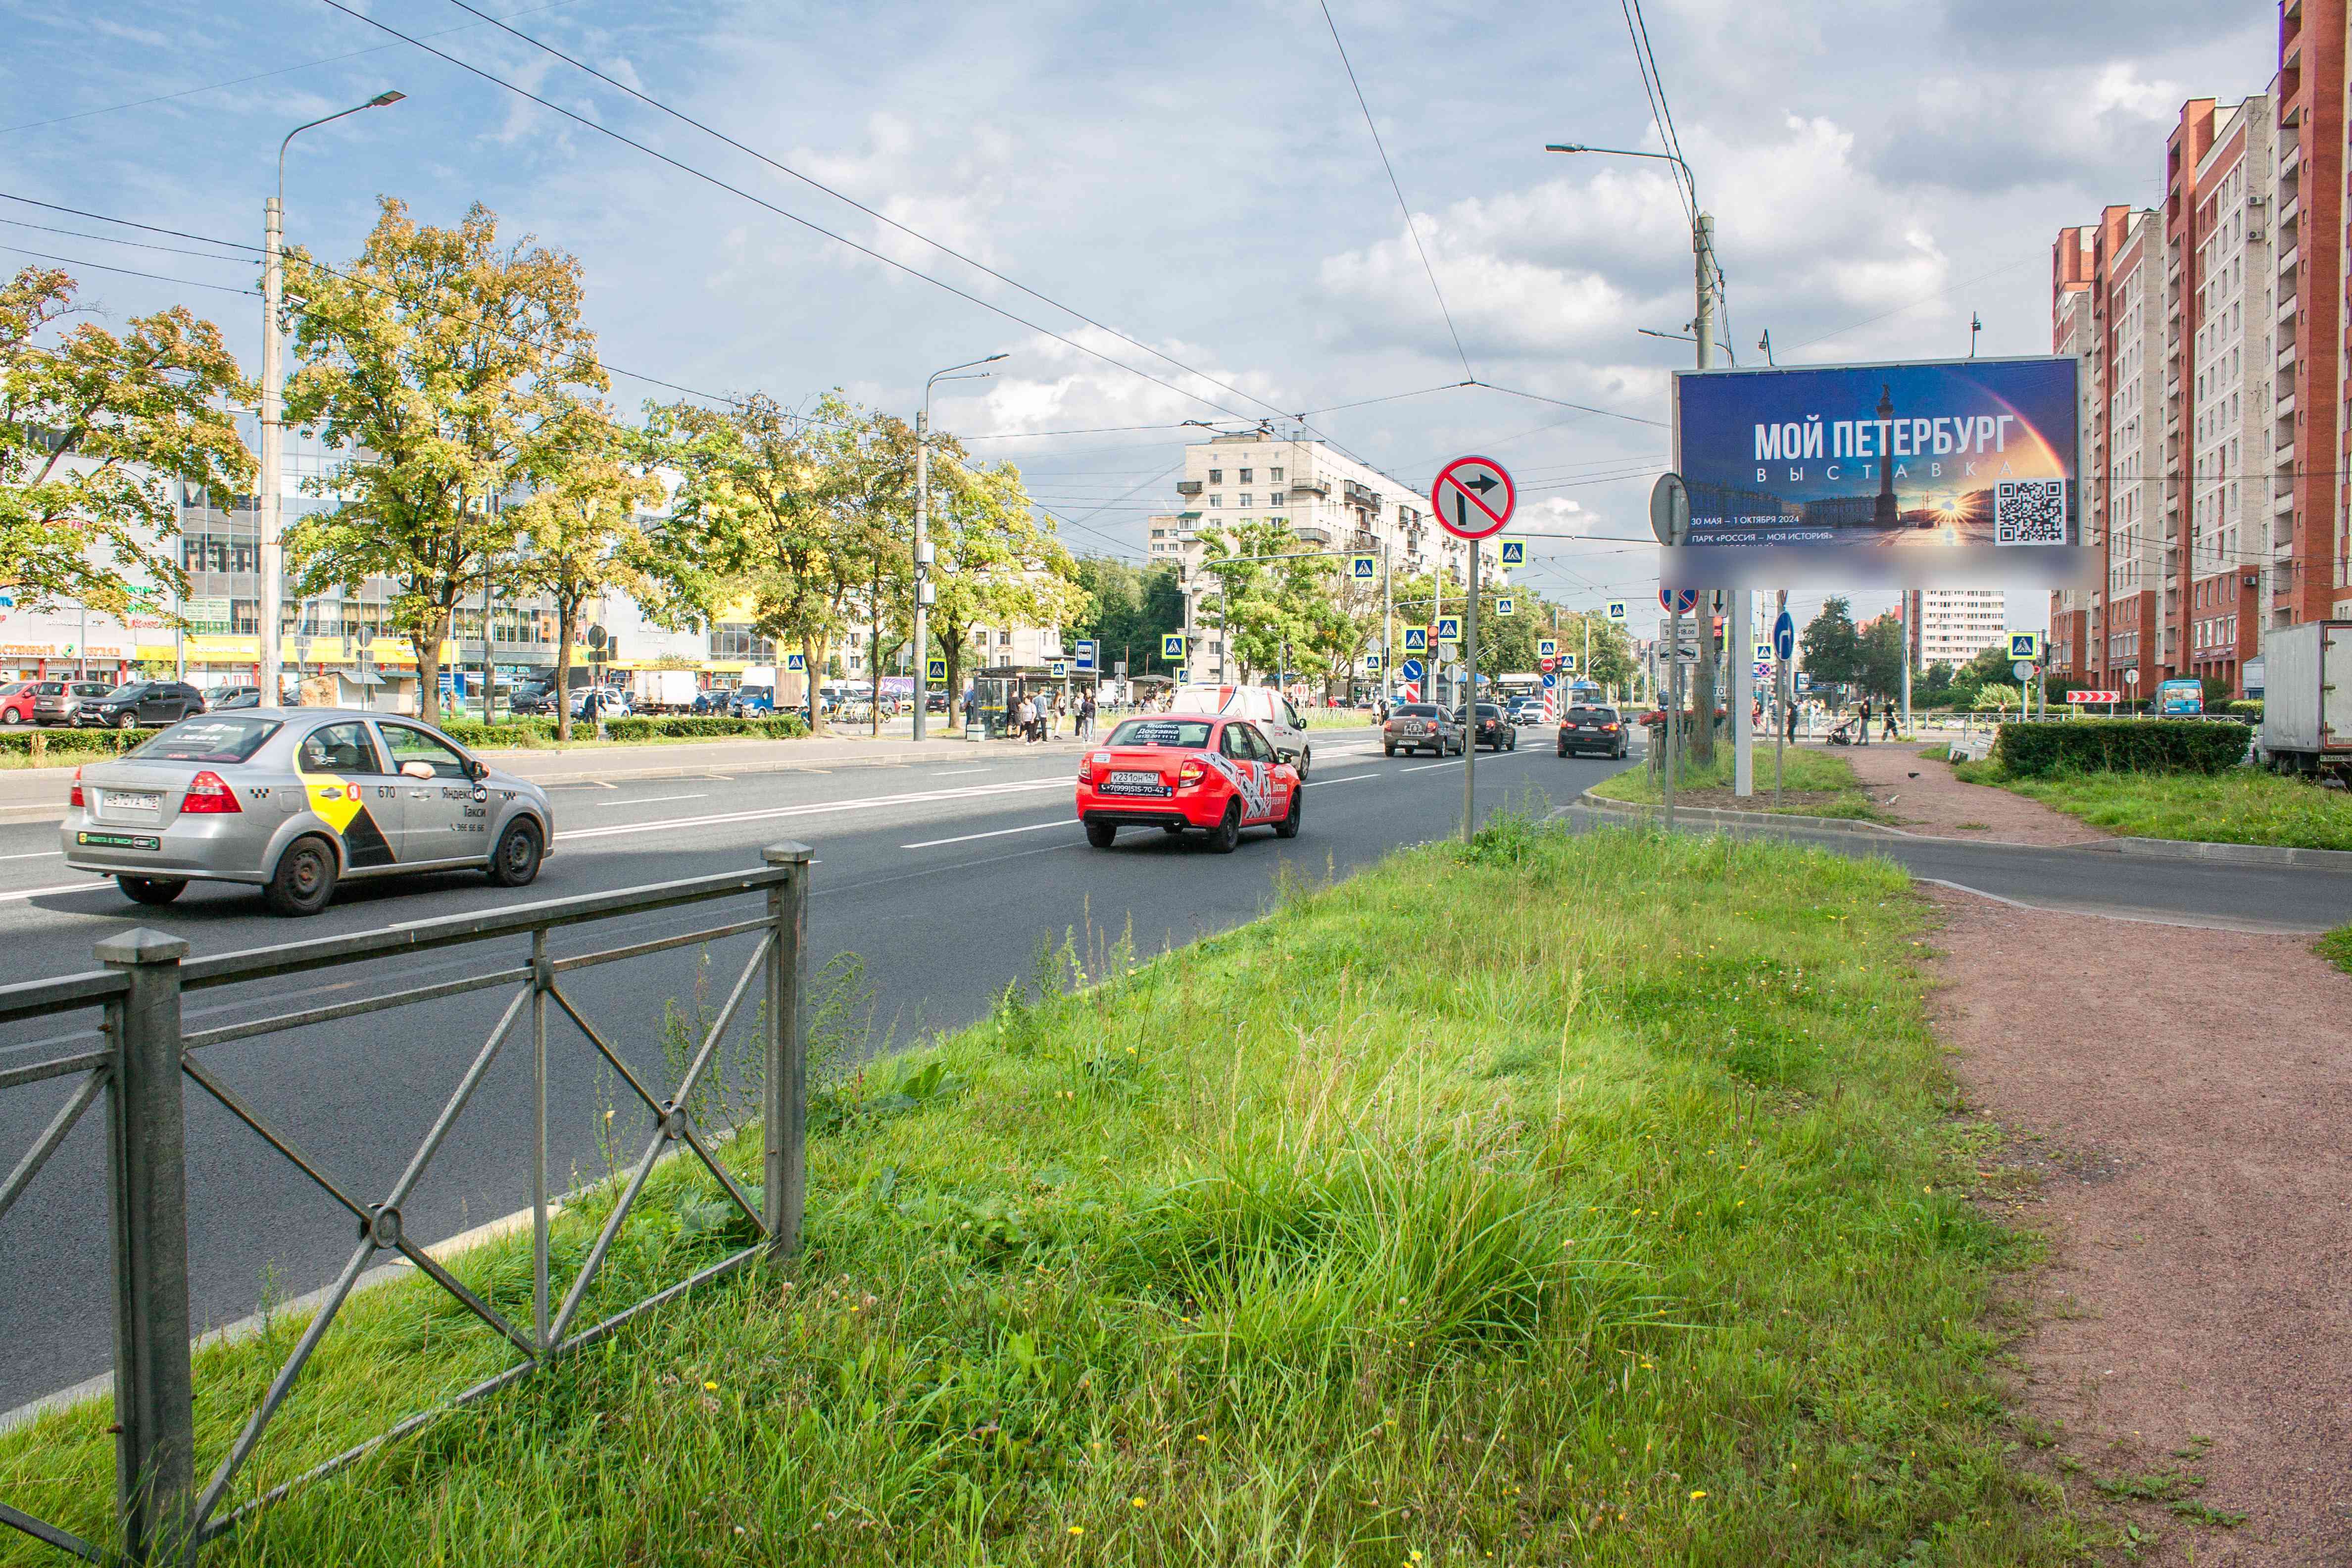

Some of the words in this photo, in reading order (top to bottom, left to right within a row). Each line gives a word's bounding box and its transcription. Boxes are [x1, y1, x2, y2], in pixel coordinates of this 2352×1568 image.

[1754, 414, 1823, 461] МОЙ
[1832, 414, 2013, 458] ПЕТЕРБУРГ
[1756, 461, 2013, 483] ВЫСТАВКА
[1739, 516, 1776, 524] ОКТЯБРЯ
[1715, 534, 1756, 542] «РОССИЯ
[1788, 532, 1833, 540] ИСТОРИЯ»
[379, 786, 396, 798] 670
[442, 786, 472, 801] Яндекс
[1107, 784, 1164, 793] +7(999)515-70-42
[463, 805, 486, 818] Такси
